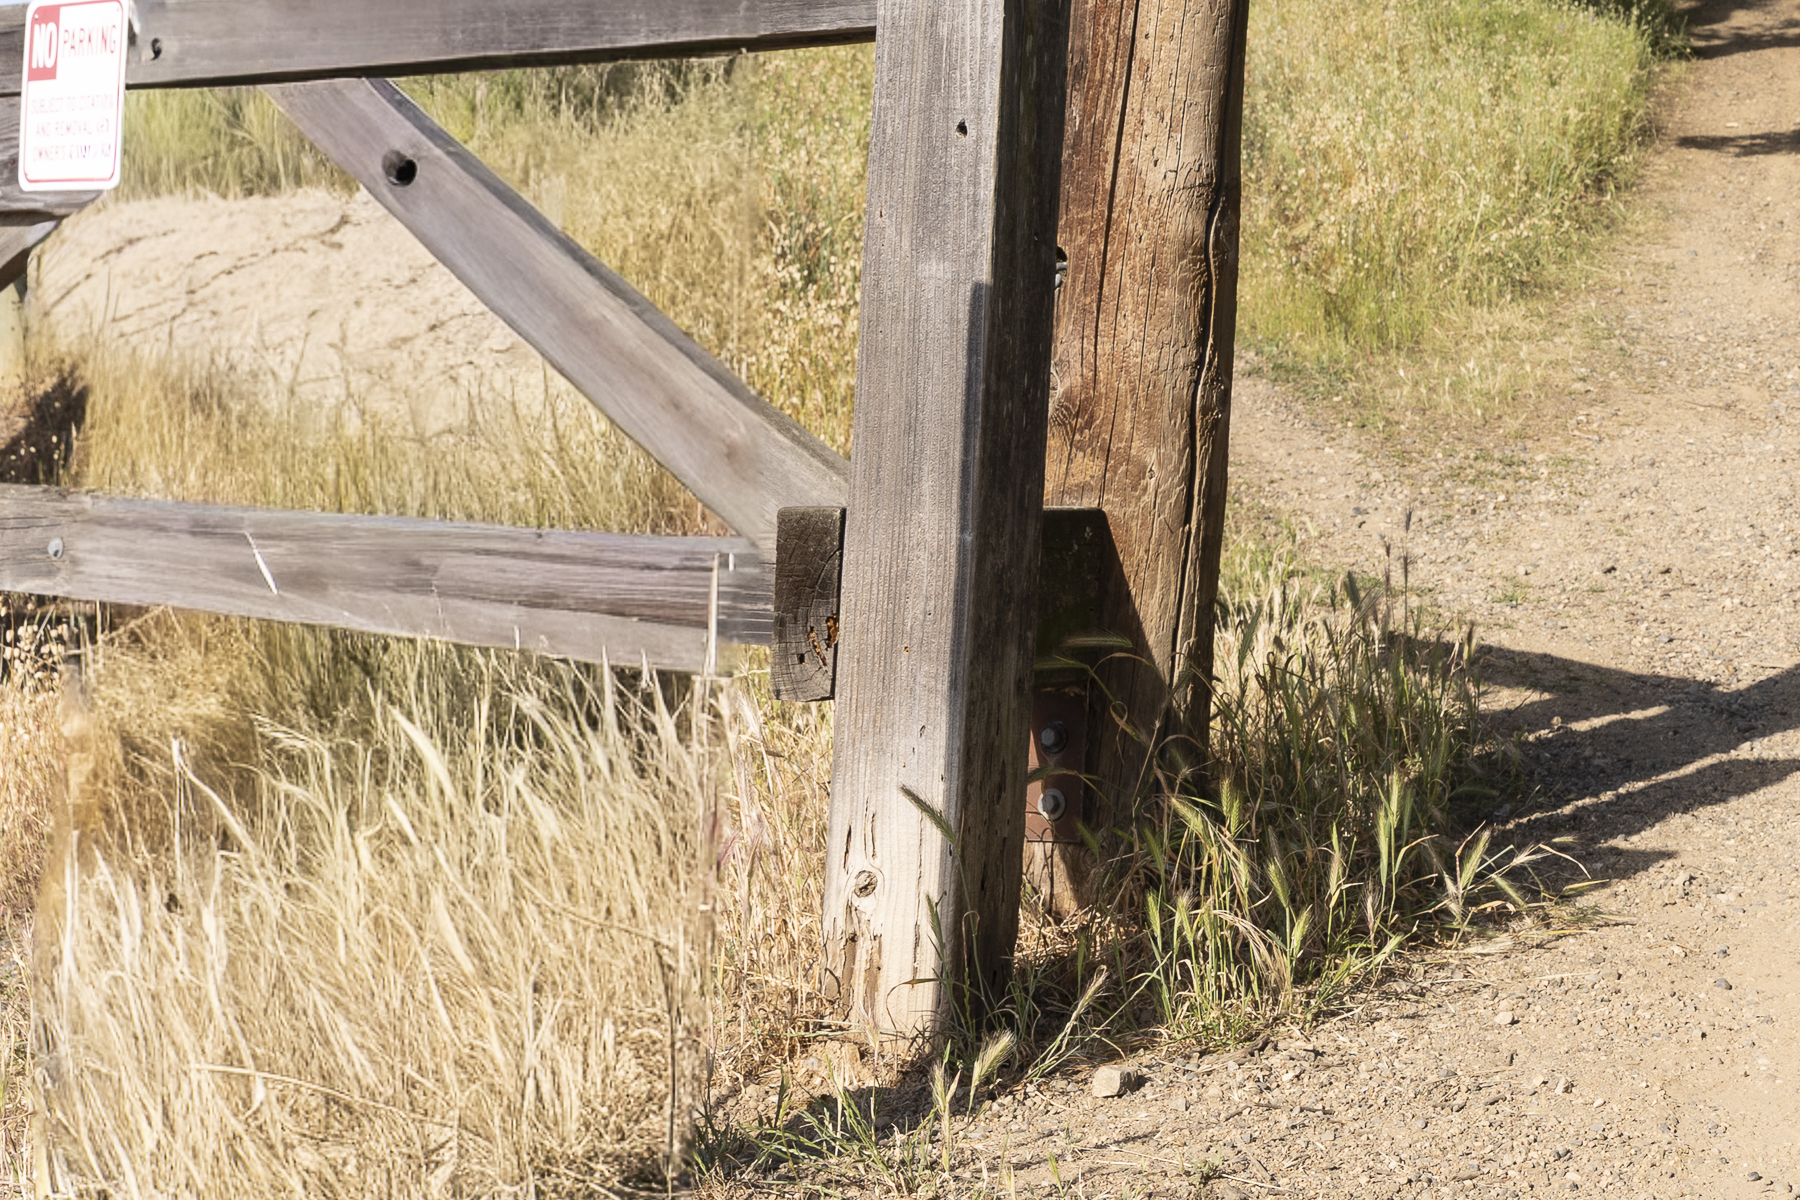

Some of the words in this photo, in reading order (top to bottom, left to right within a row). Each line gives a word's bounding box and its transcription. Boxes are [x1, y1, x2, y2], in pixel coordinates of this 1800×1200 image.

[31, 22, 58, 69] NO
[62, 25, 117, 57] PARKING
[67, 96, 77, 112] TO
